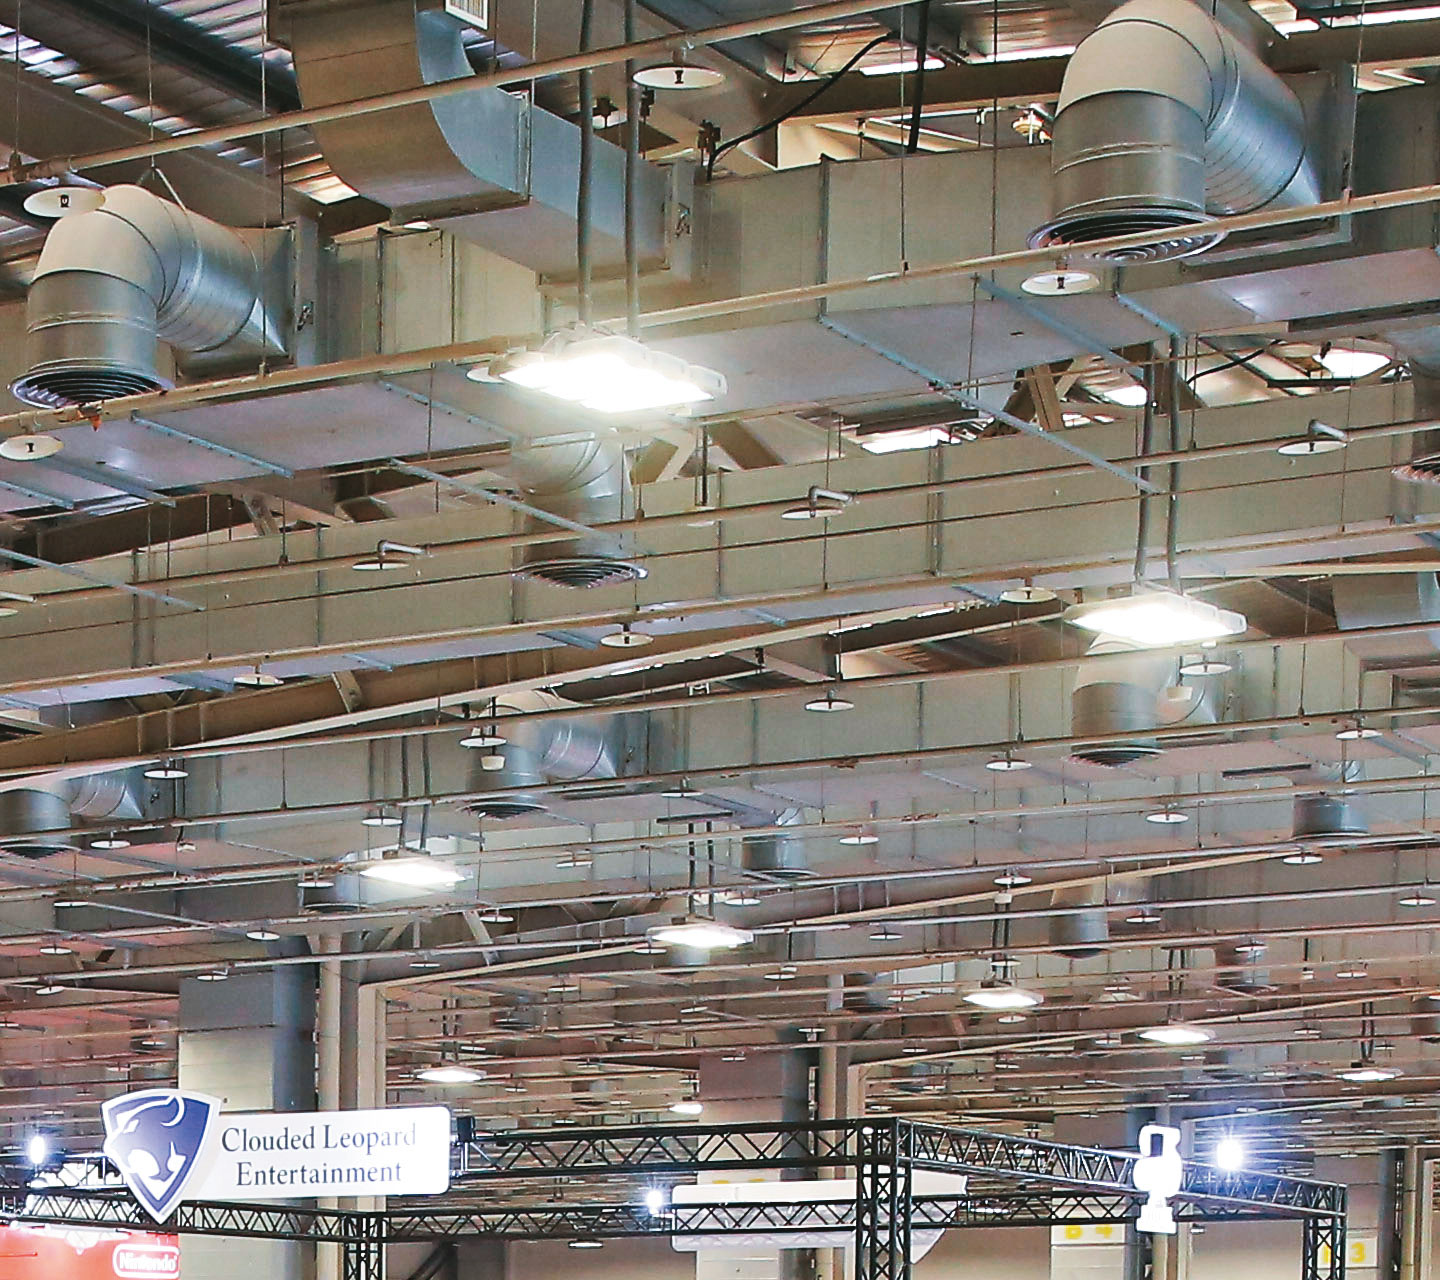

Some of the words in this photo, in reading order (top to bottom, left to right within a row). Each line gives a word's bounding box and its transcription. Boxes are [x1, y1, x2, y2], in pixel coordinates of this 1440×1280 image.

[222, 1126, 316, 1152] Clouded
[323, 1123, 417, 1154] Leopard
[236, 1161, 404, 1187] Entertainment
[119, 1251, 177, 1272] Nintendo
